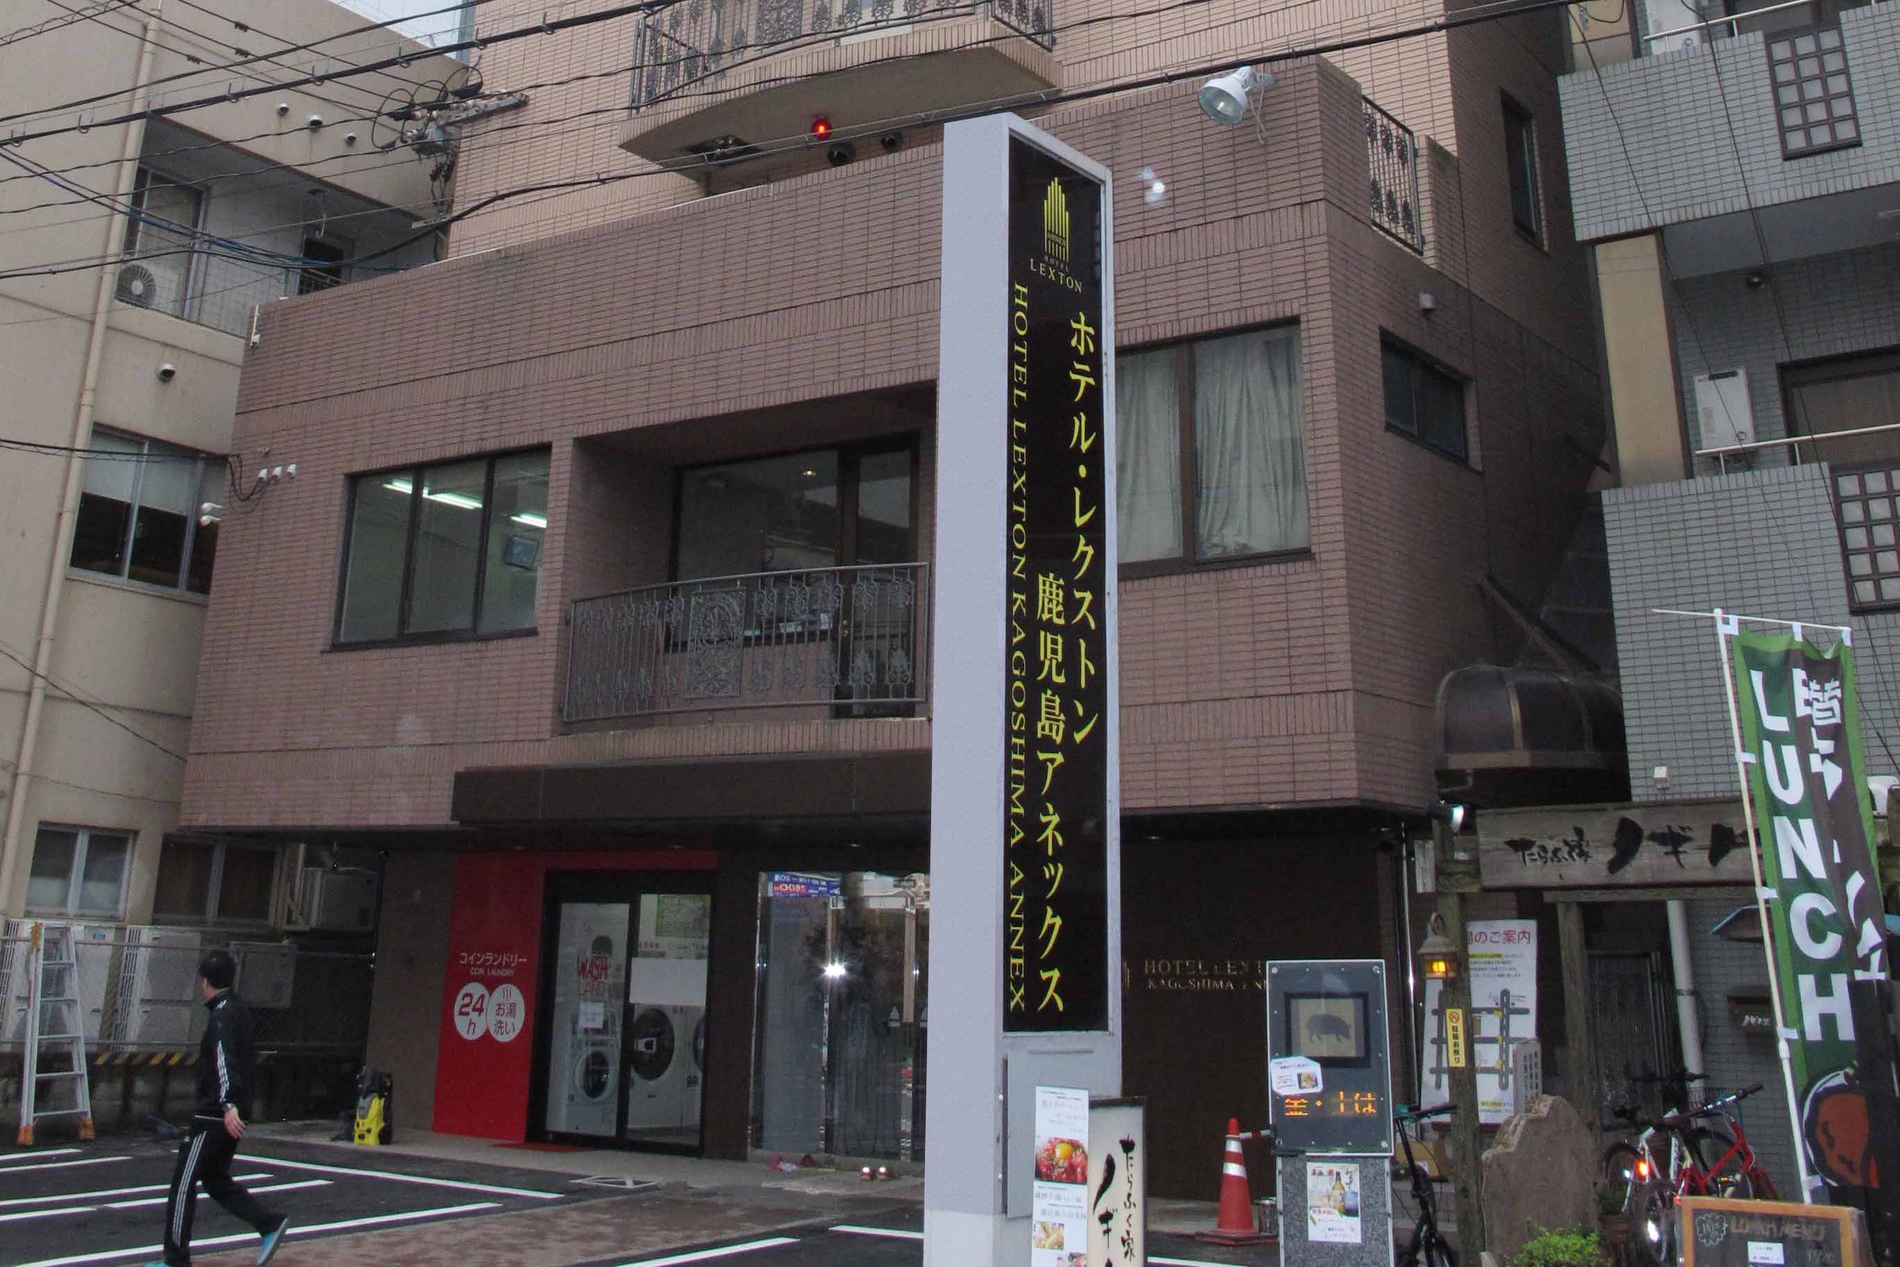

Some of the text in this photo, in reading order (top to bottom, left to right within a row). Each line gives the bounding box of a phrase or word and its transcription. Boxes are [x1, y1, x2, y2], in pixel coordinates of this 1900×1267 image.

[1030, 258, 1083, 294] LEXTON
[1069, 311, 1098, 745] ホテル・レクストン
[1010, 282, 1029, 1012] HOTEL LEXTON KAGOSHIMA ANNEX
[1036, 572, 1066, 1012] 鹿児島アネックス
[1750, 669, 1856, 1042] LUNCH
[459, 952, 528, 967] コインランドリー
[458, 992, 486, 1018] 24
[495, 1002, 518, 1018] お湯
[493, 1018, 517, 1035] 洗い
